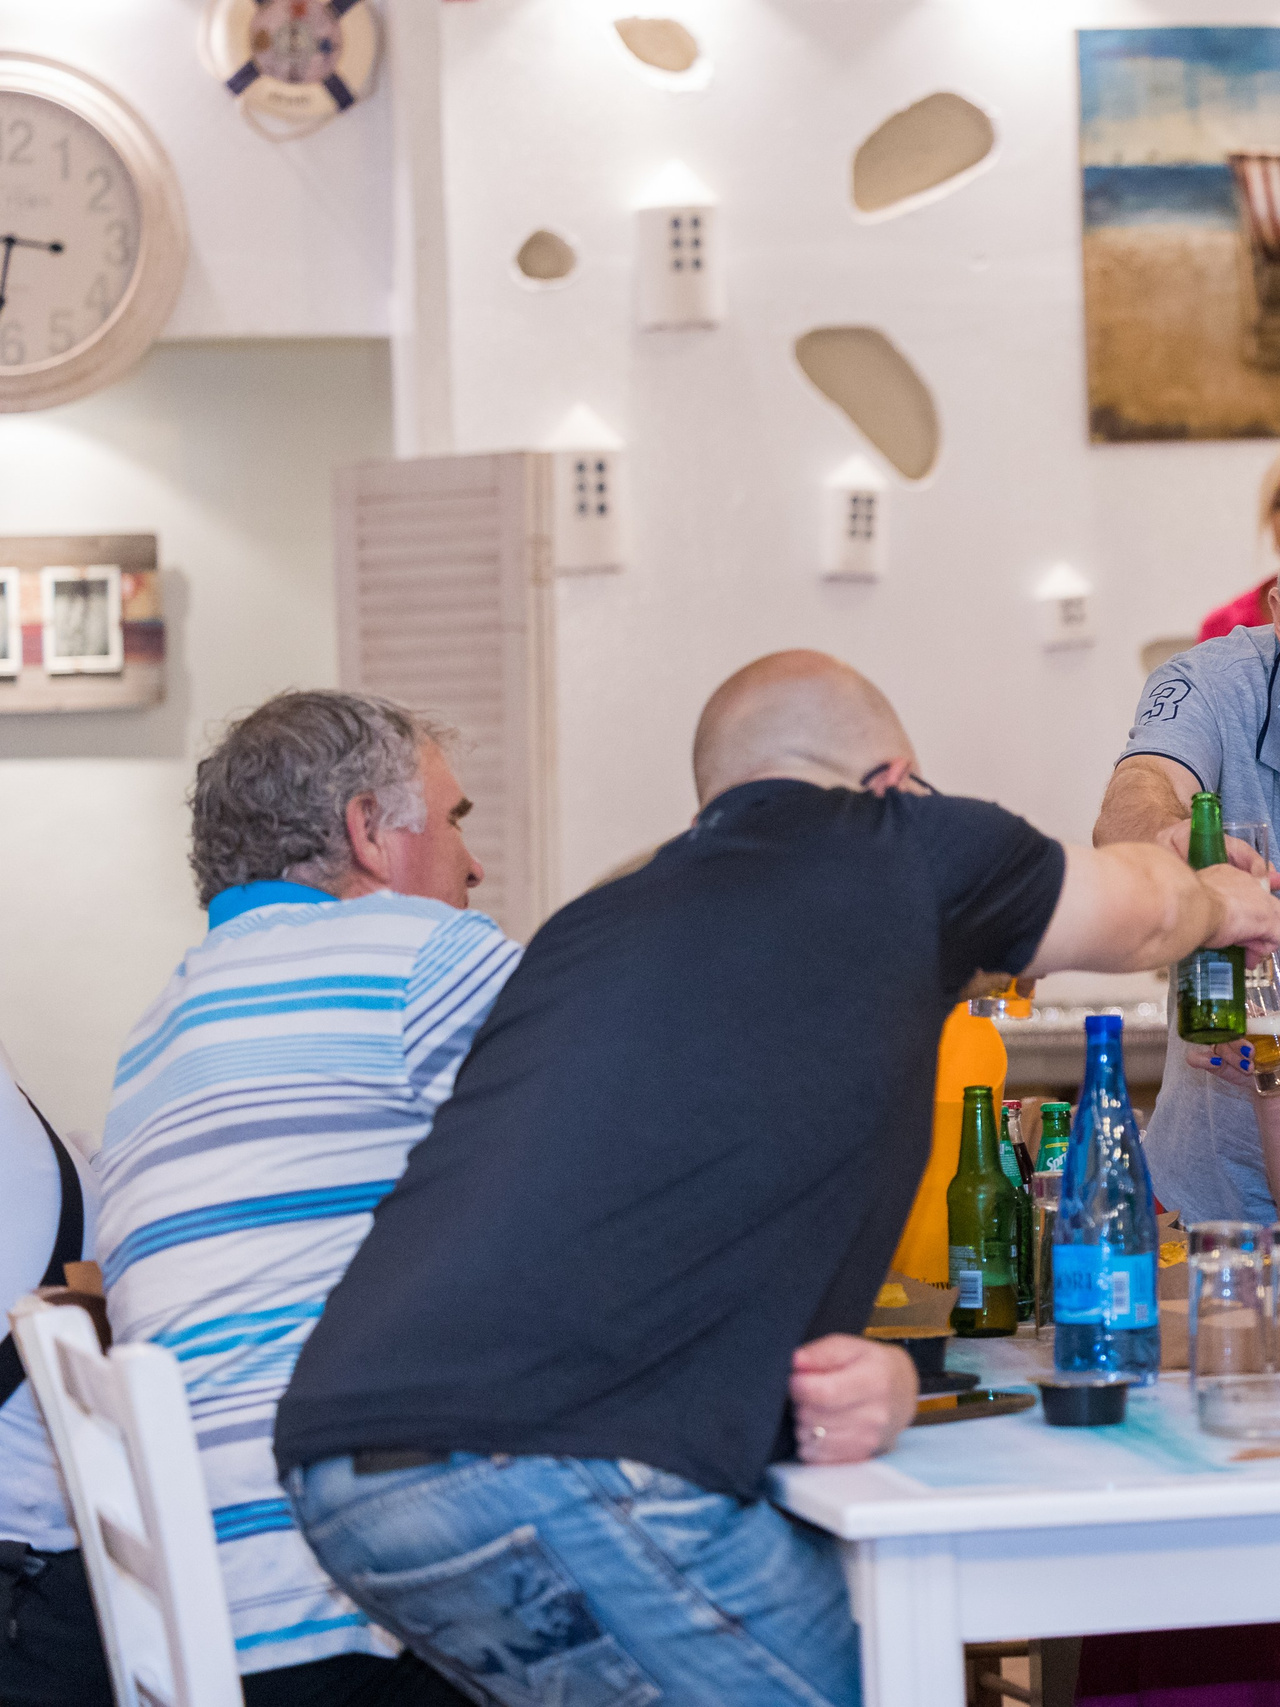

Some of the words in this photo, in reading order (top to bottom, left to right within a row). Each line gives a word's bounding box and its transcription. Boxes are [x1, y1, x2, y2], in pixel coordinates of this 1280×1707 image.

[54, 137, 71, 181] 1
[85, 166, 114, 214] 2
[104, 219, 131, 266] 3
[83, 272, 109, 322] 4
[48, 307, 76, 356] 5
